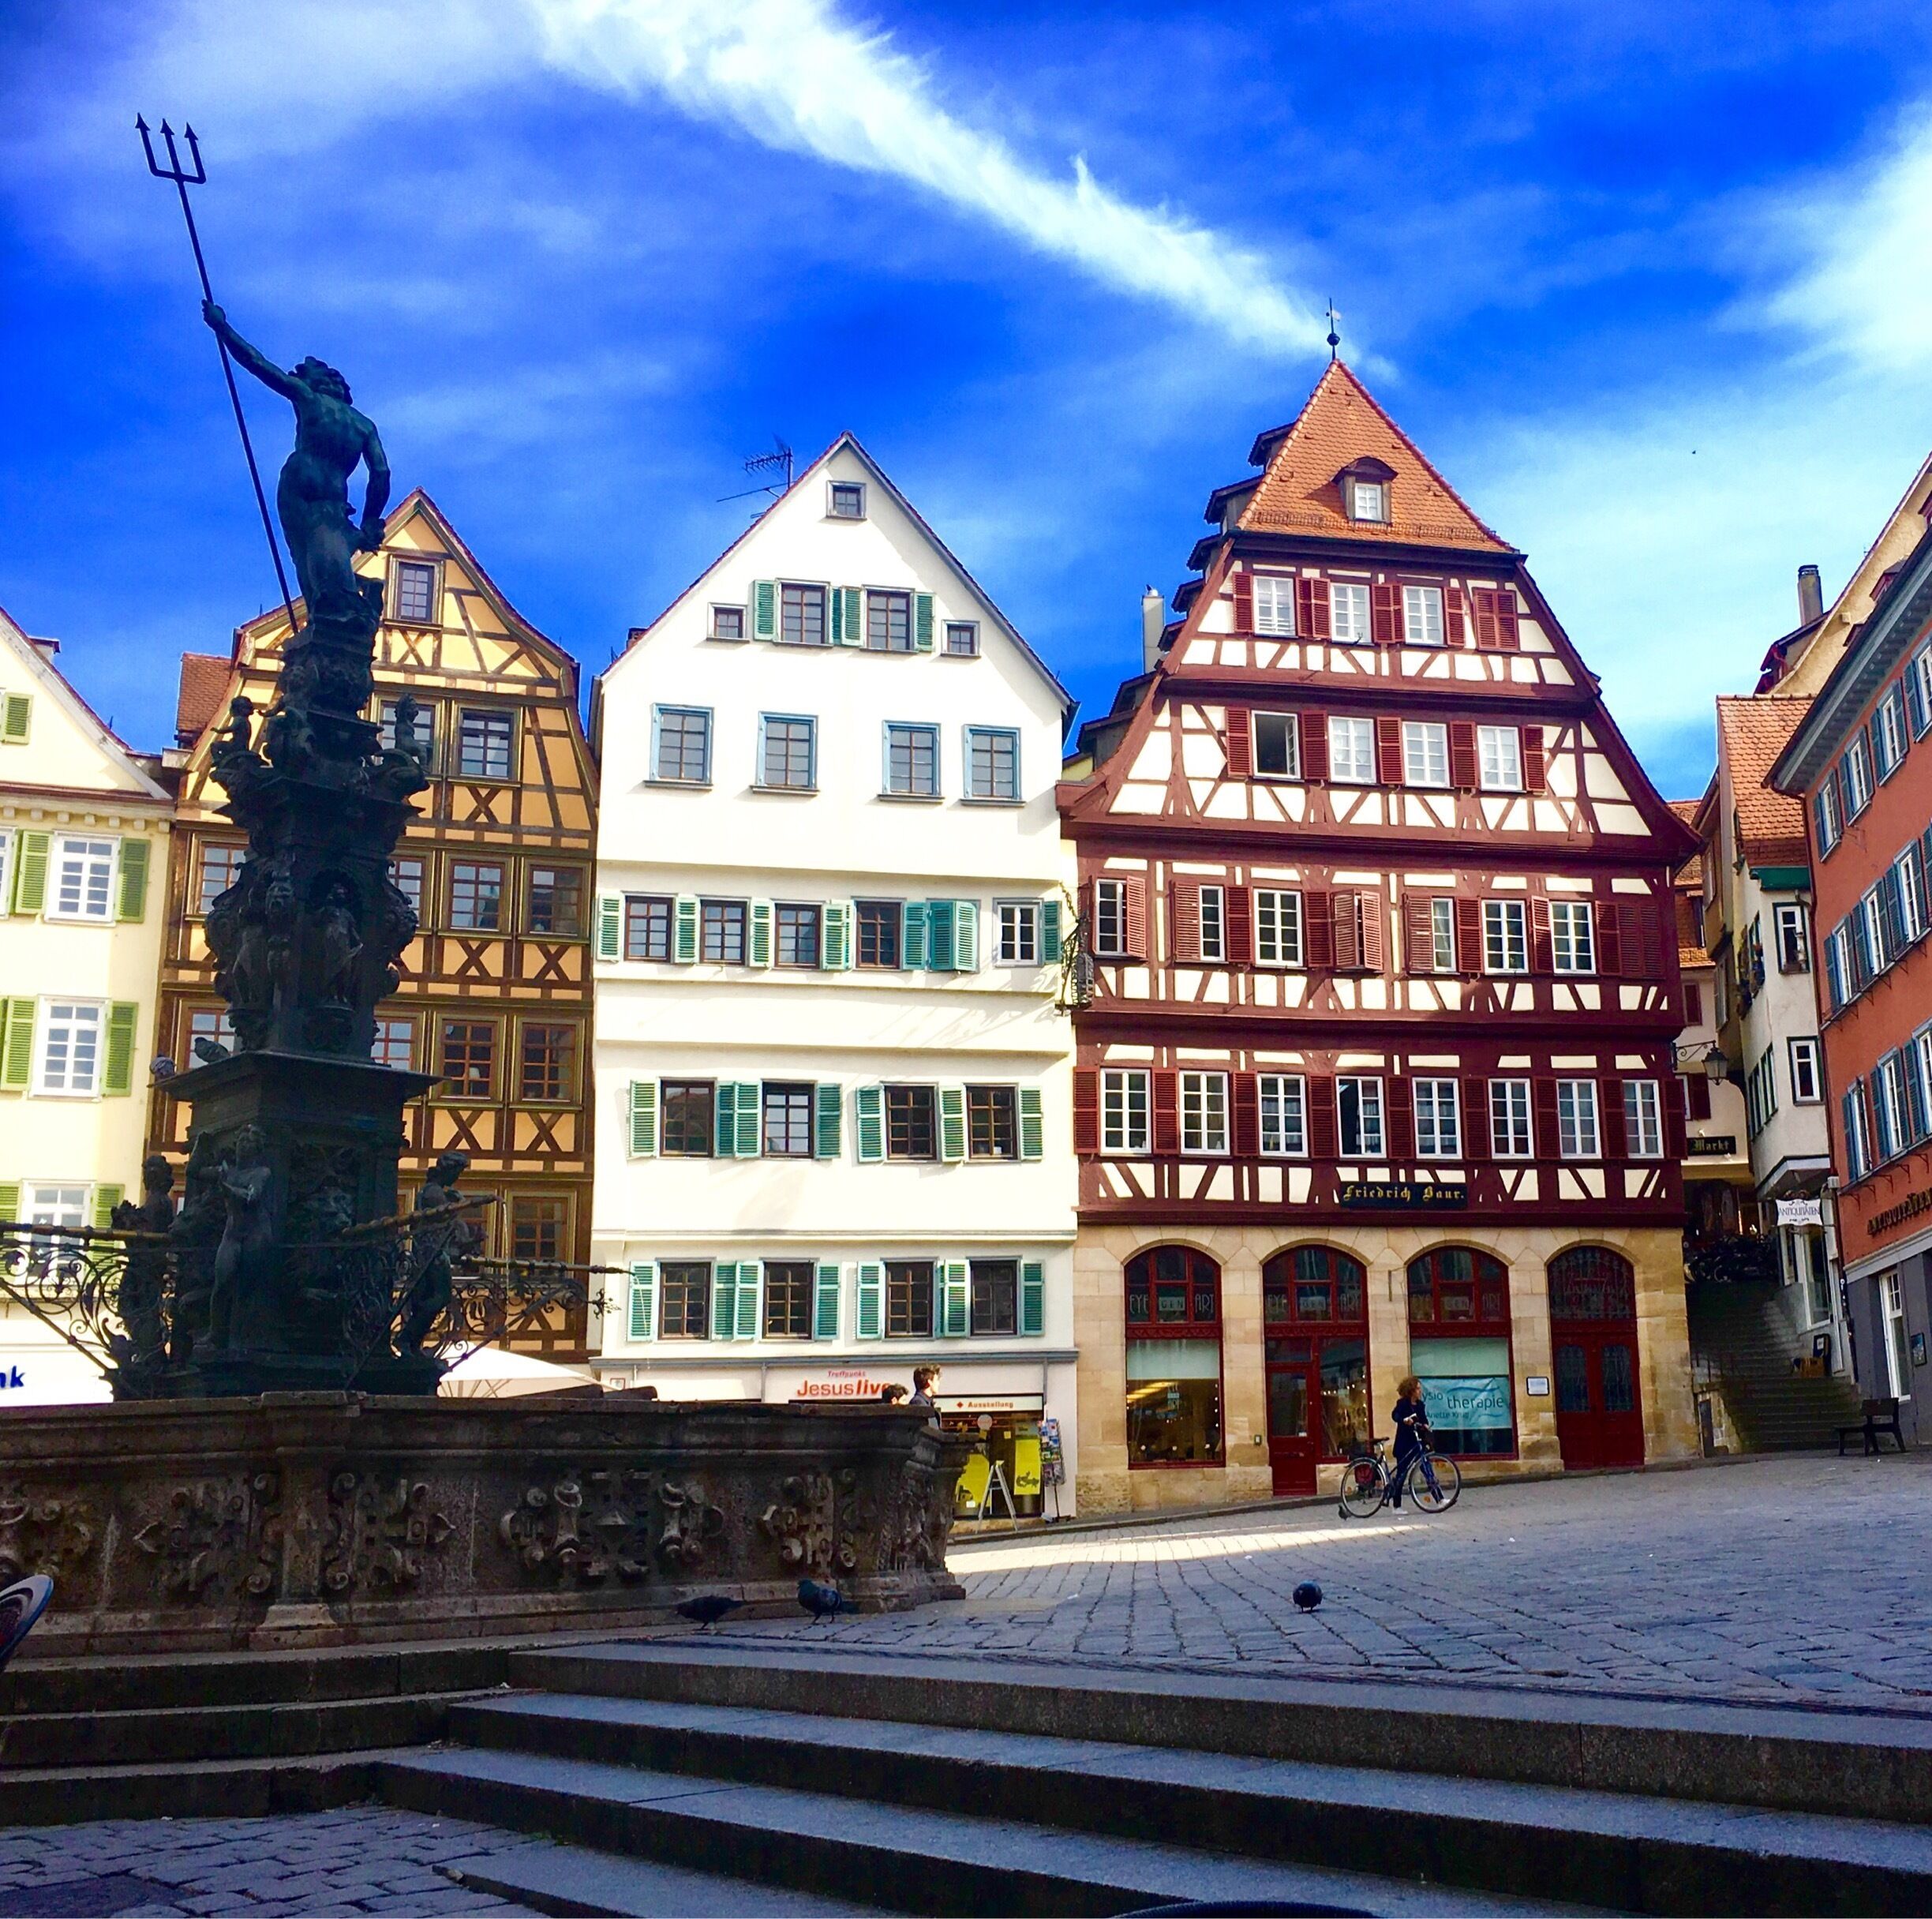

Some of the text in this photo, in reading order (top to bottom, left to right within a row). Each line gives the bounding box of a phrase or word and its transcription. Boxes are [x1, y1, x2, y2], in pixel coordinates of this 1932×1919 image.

[1343, 1185, 1410, 1201] Friedrich
[1129, 1295, 1148, 1314] EYE
[1195, 1295, 1214, 1314] ART
[1447, 1395, 1503, 1410] therapie
